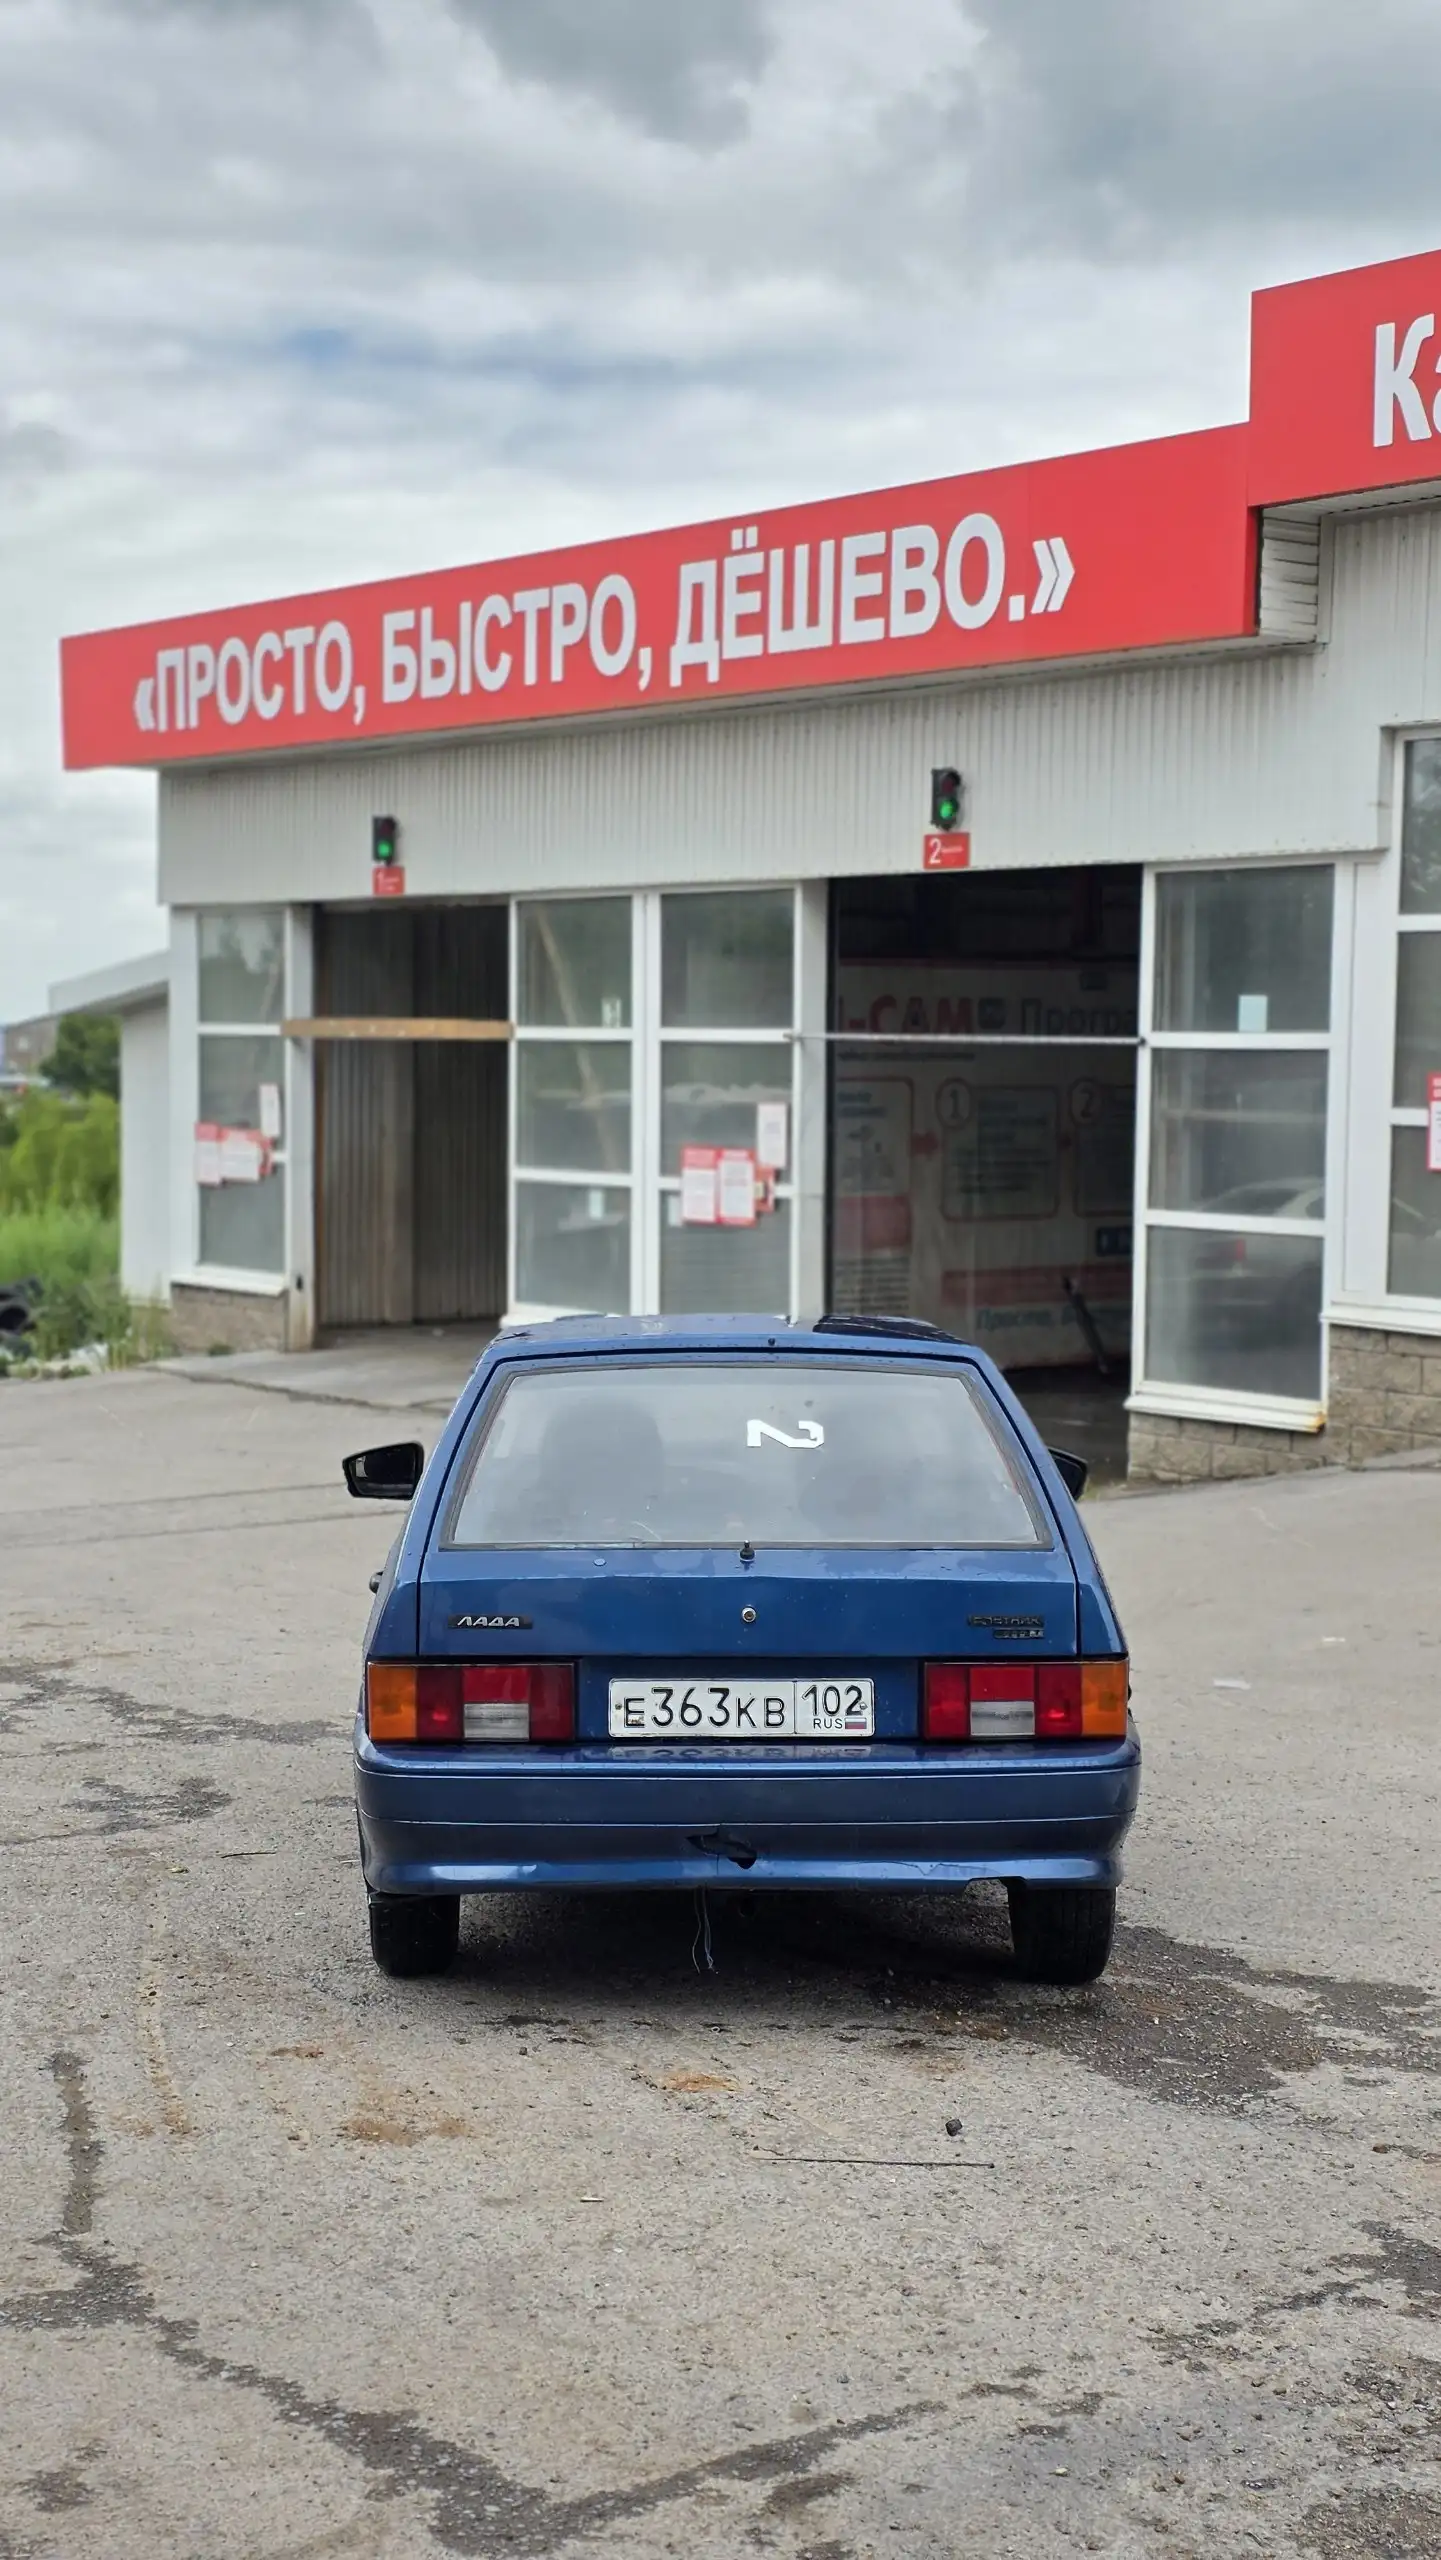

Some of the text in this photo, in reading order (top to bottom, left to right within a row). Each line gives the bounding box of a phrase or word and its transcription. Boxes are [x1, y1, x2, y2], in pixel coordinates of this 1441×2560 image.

[1373, 313, 1441, 447] К
[133, 512, 1075, 732] «ПРОСТО, БЫСТРО, ДЁШЕВО.»
[929, 838, 941, 864] 2
[457, 1616, 520, 1627] ЛАДА
[624, 1685, 864, 1728] Е363КВ 102
[813, 1717, 843, 1730] RUS
